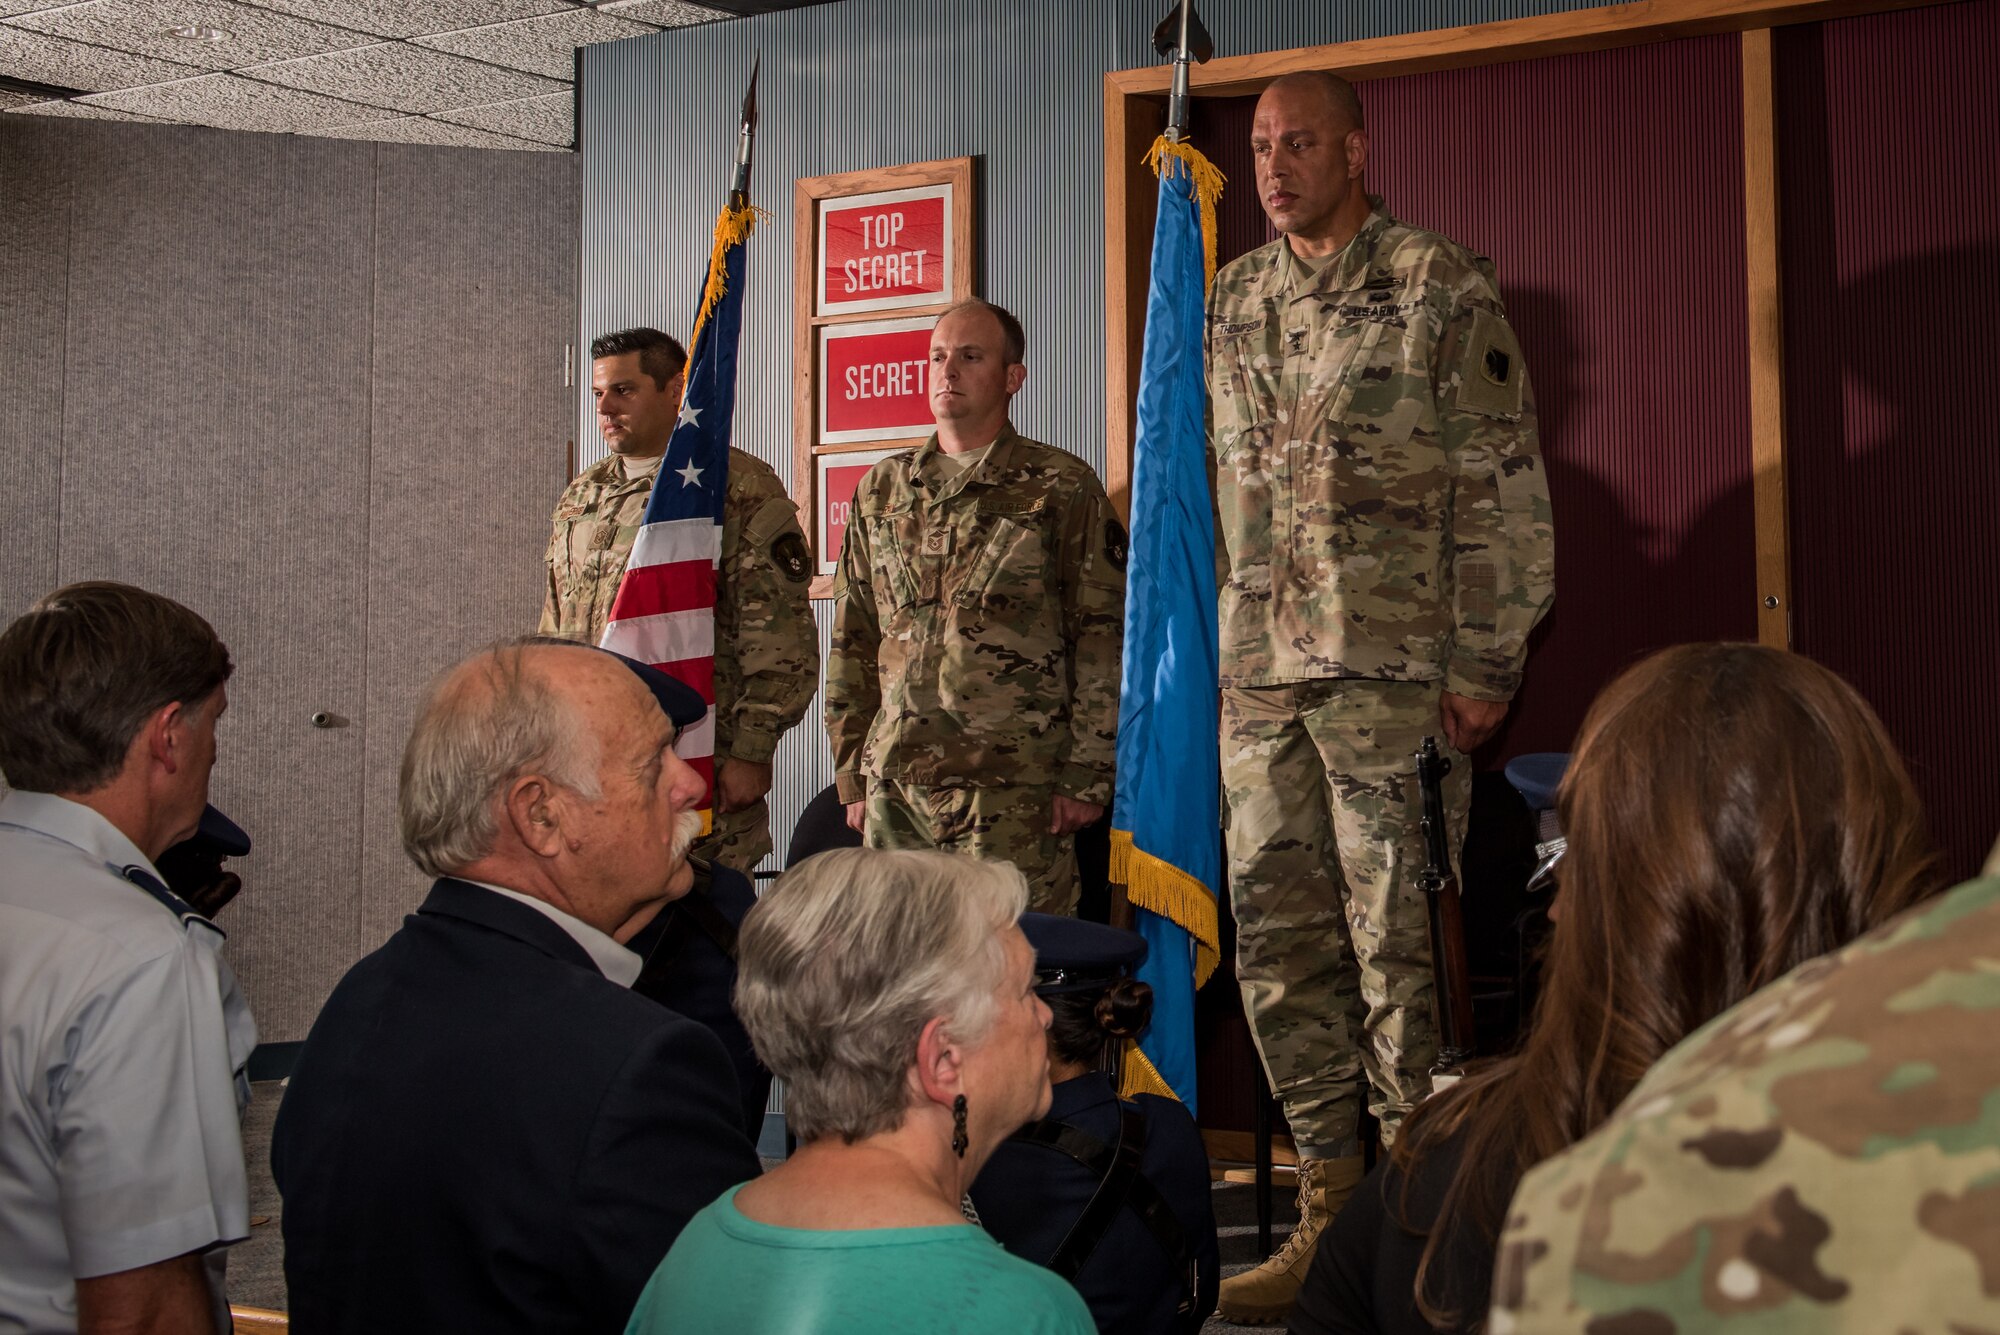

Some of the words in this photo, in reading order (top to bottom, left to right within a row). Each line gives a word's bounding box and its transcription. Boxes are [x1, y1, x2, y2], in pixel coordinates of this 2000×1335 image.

[859, 211, 904, 250] TOP
[844, 249, 927, 294] SECRET
[1370, 304, 1401, 317] ARMY
[1220, 319, 1262, 335] THOMPSON
[845, 359, 928, 401] SECRET
[998, 502, 1014, 512] AIR
[1015, 498, 1045, 512] FORCE
